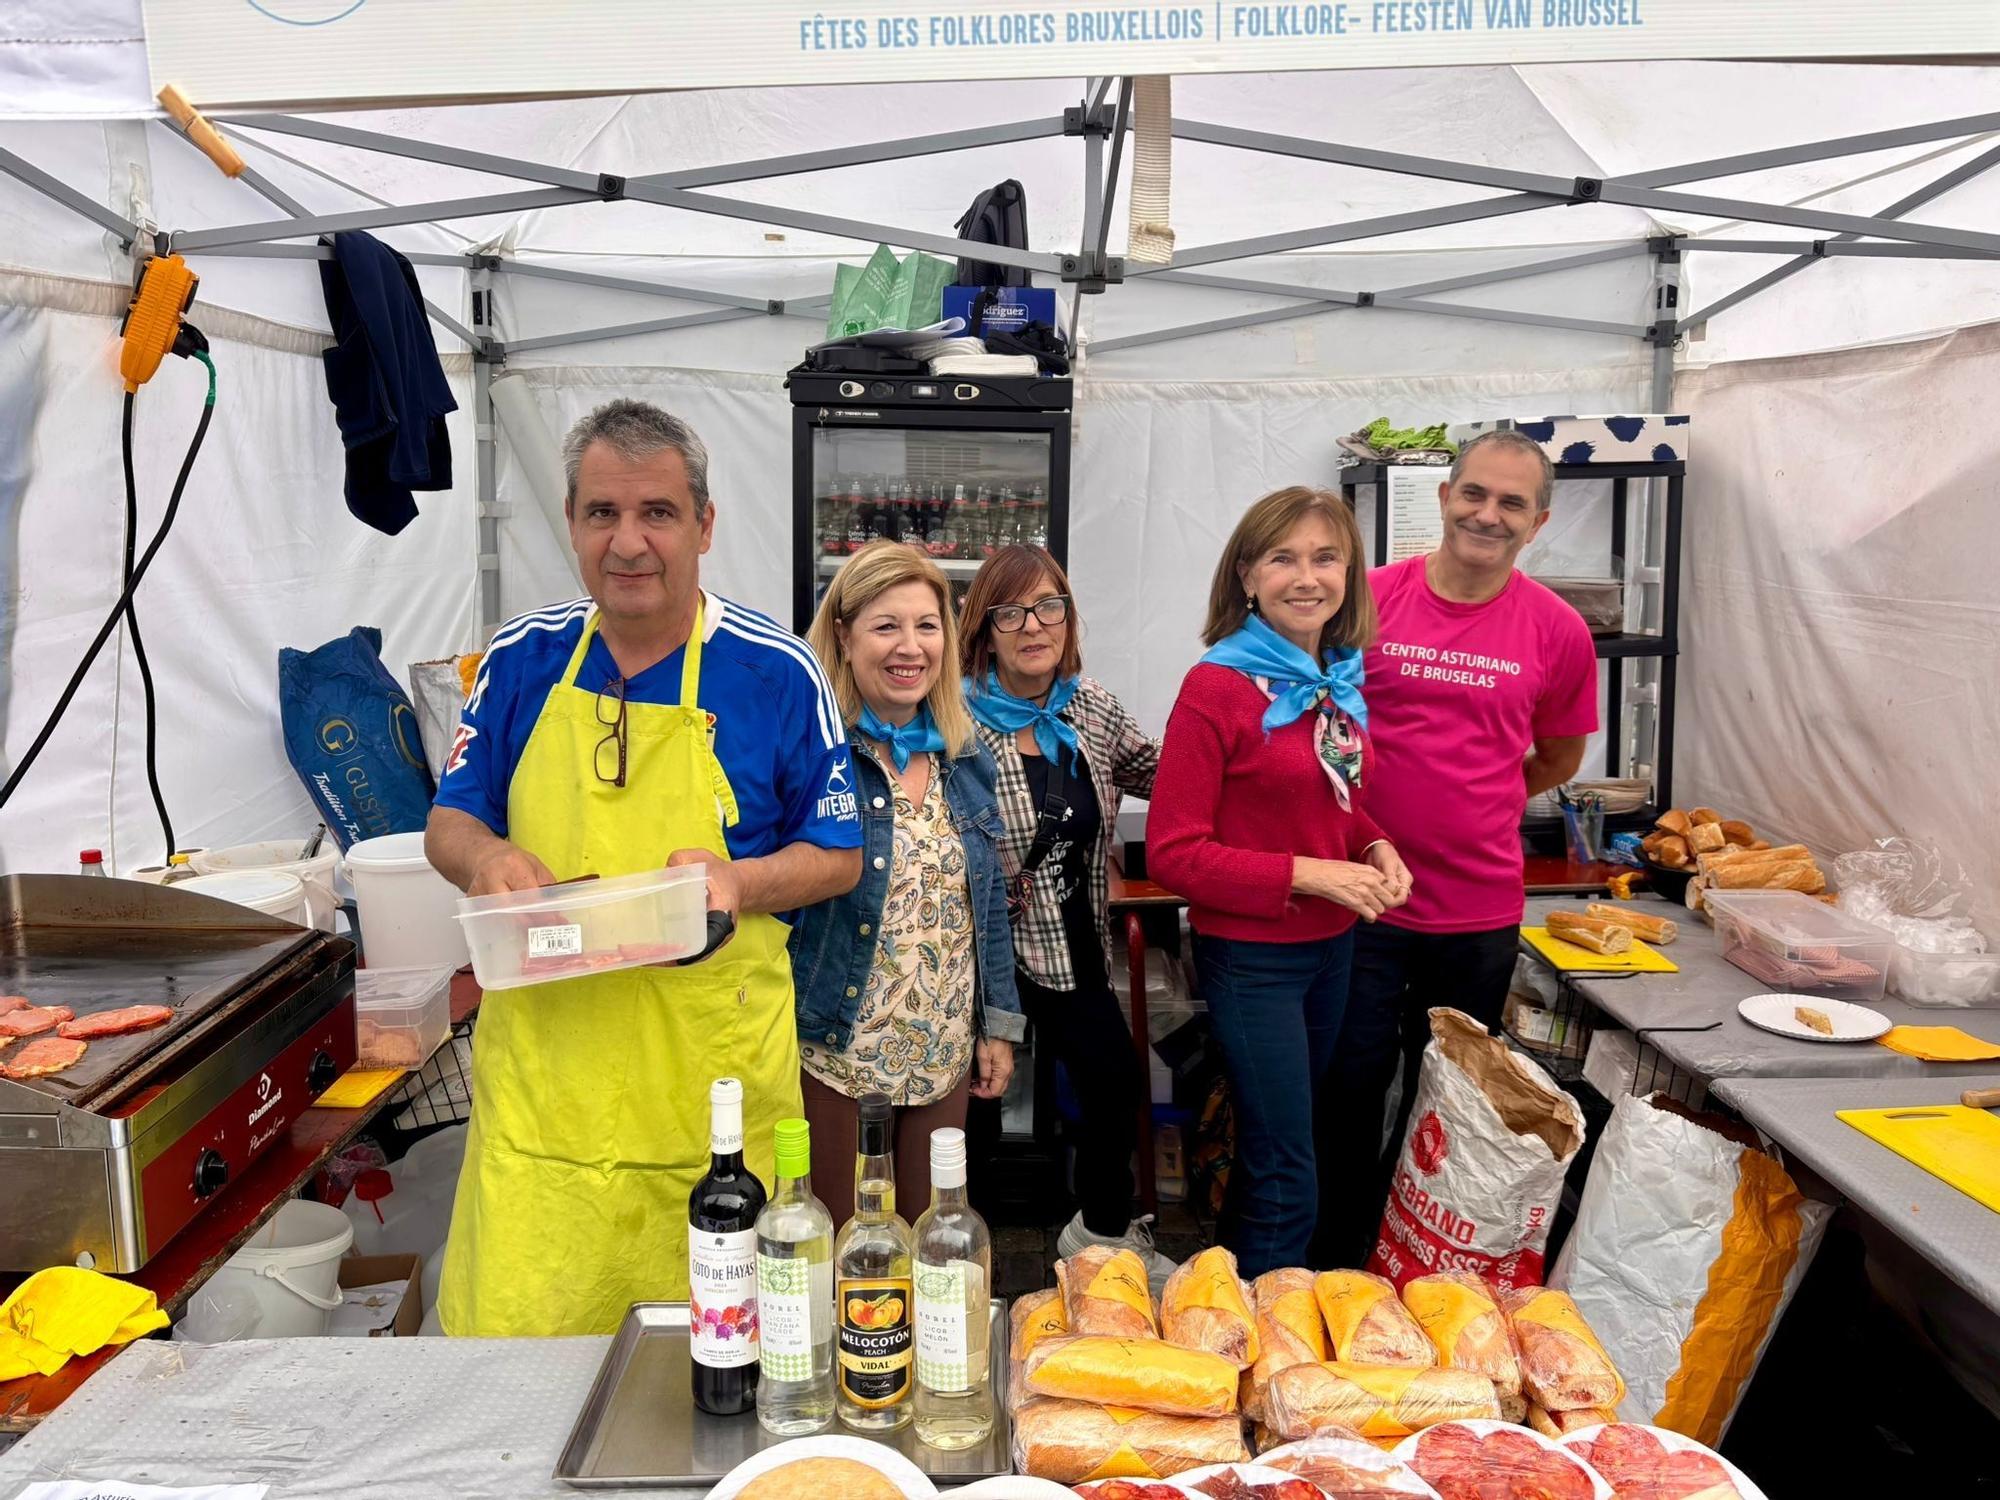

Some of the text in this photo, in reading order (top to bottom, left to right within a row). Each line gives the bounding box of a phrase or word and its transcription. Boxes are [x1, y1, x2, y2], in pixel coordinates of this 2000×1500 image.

[800, 0, 1643, 51] FÊTES DES FOLKLORES BRUXELLOIS FOLKLORE- FEESTEN VAN BRUSSEL
[1382, 642, 1521, 675] CENTRO ASTURIANO
[1400, 662, 1496, 688] DE BRUSELAS
[312, 772, 361, 844] Tradition Fra
[817, 792, 857, 819] INTEGR
[248, 1087, 283, 1126] Diamond
[1526, 1206, 1546, 1229] kg
[693, 1258, 755, 1281] COTO DE HAYAS
[1376, 1239, 1404, 1279] 25 kg
[841, 1329, 910, 1348] MELOCOTÓN
[863, 1348, 887, 1356] PEACH
[860, 1361, 890, 1370] VIDAL
